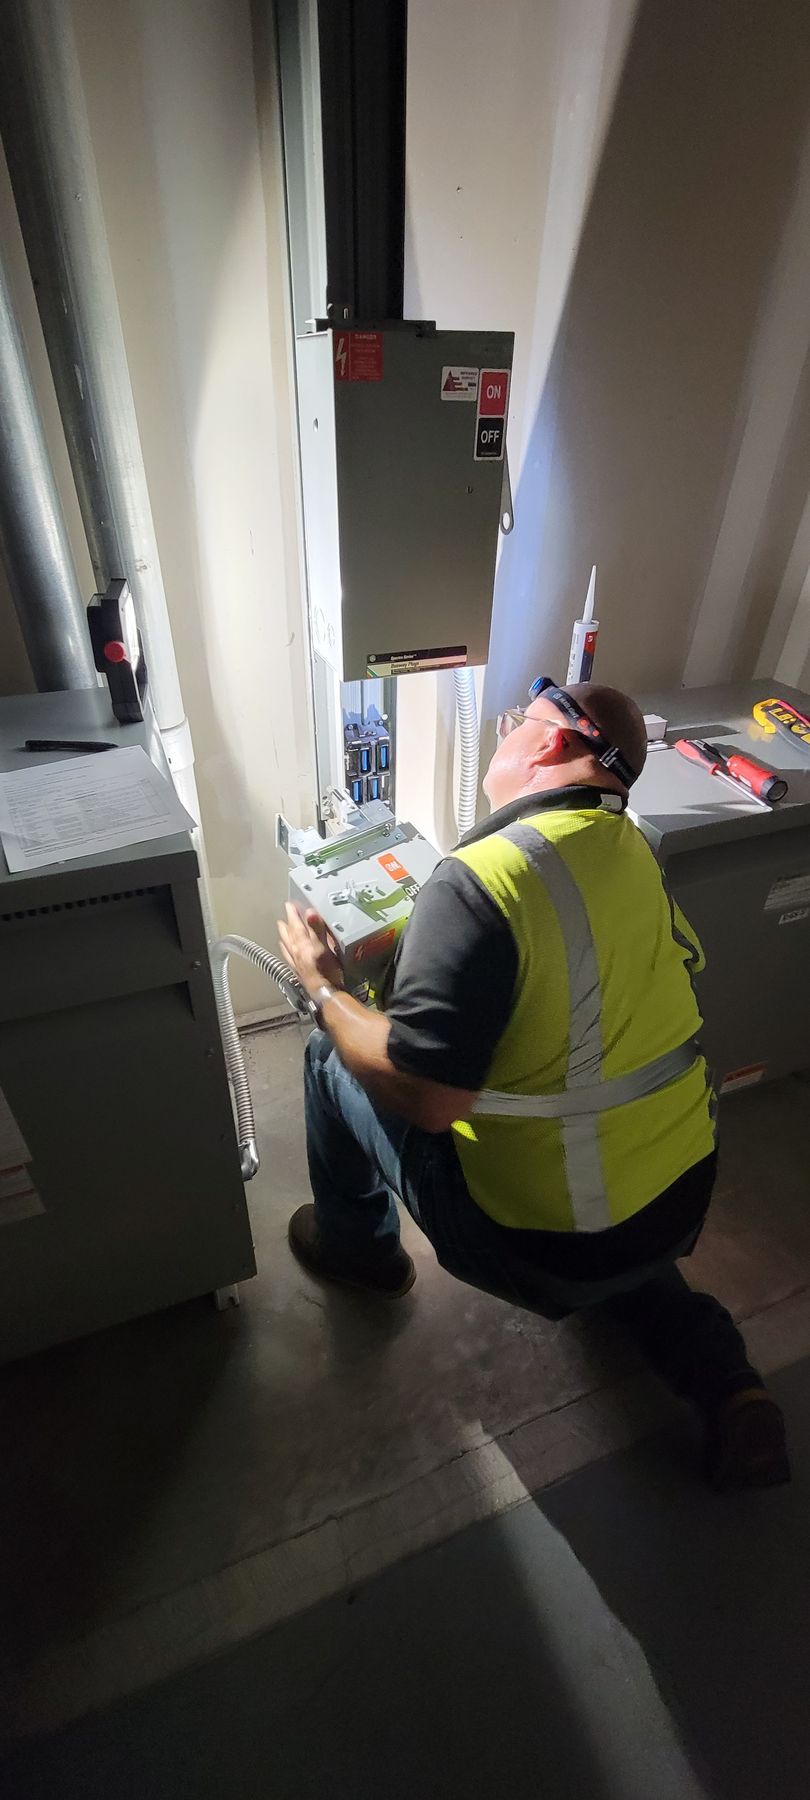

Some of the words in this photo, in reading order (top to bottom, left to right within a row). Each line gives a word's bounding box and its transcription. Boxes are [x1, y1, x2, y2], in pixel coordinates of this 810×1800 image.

[487, 385, 501, 399] ON
[481, 430, 500, 443] OFF
[385, 860, 402, 872] ON
[405, 884, 420, 897] OFF
